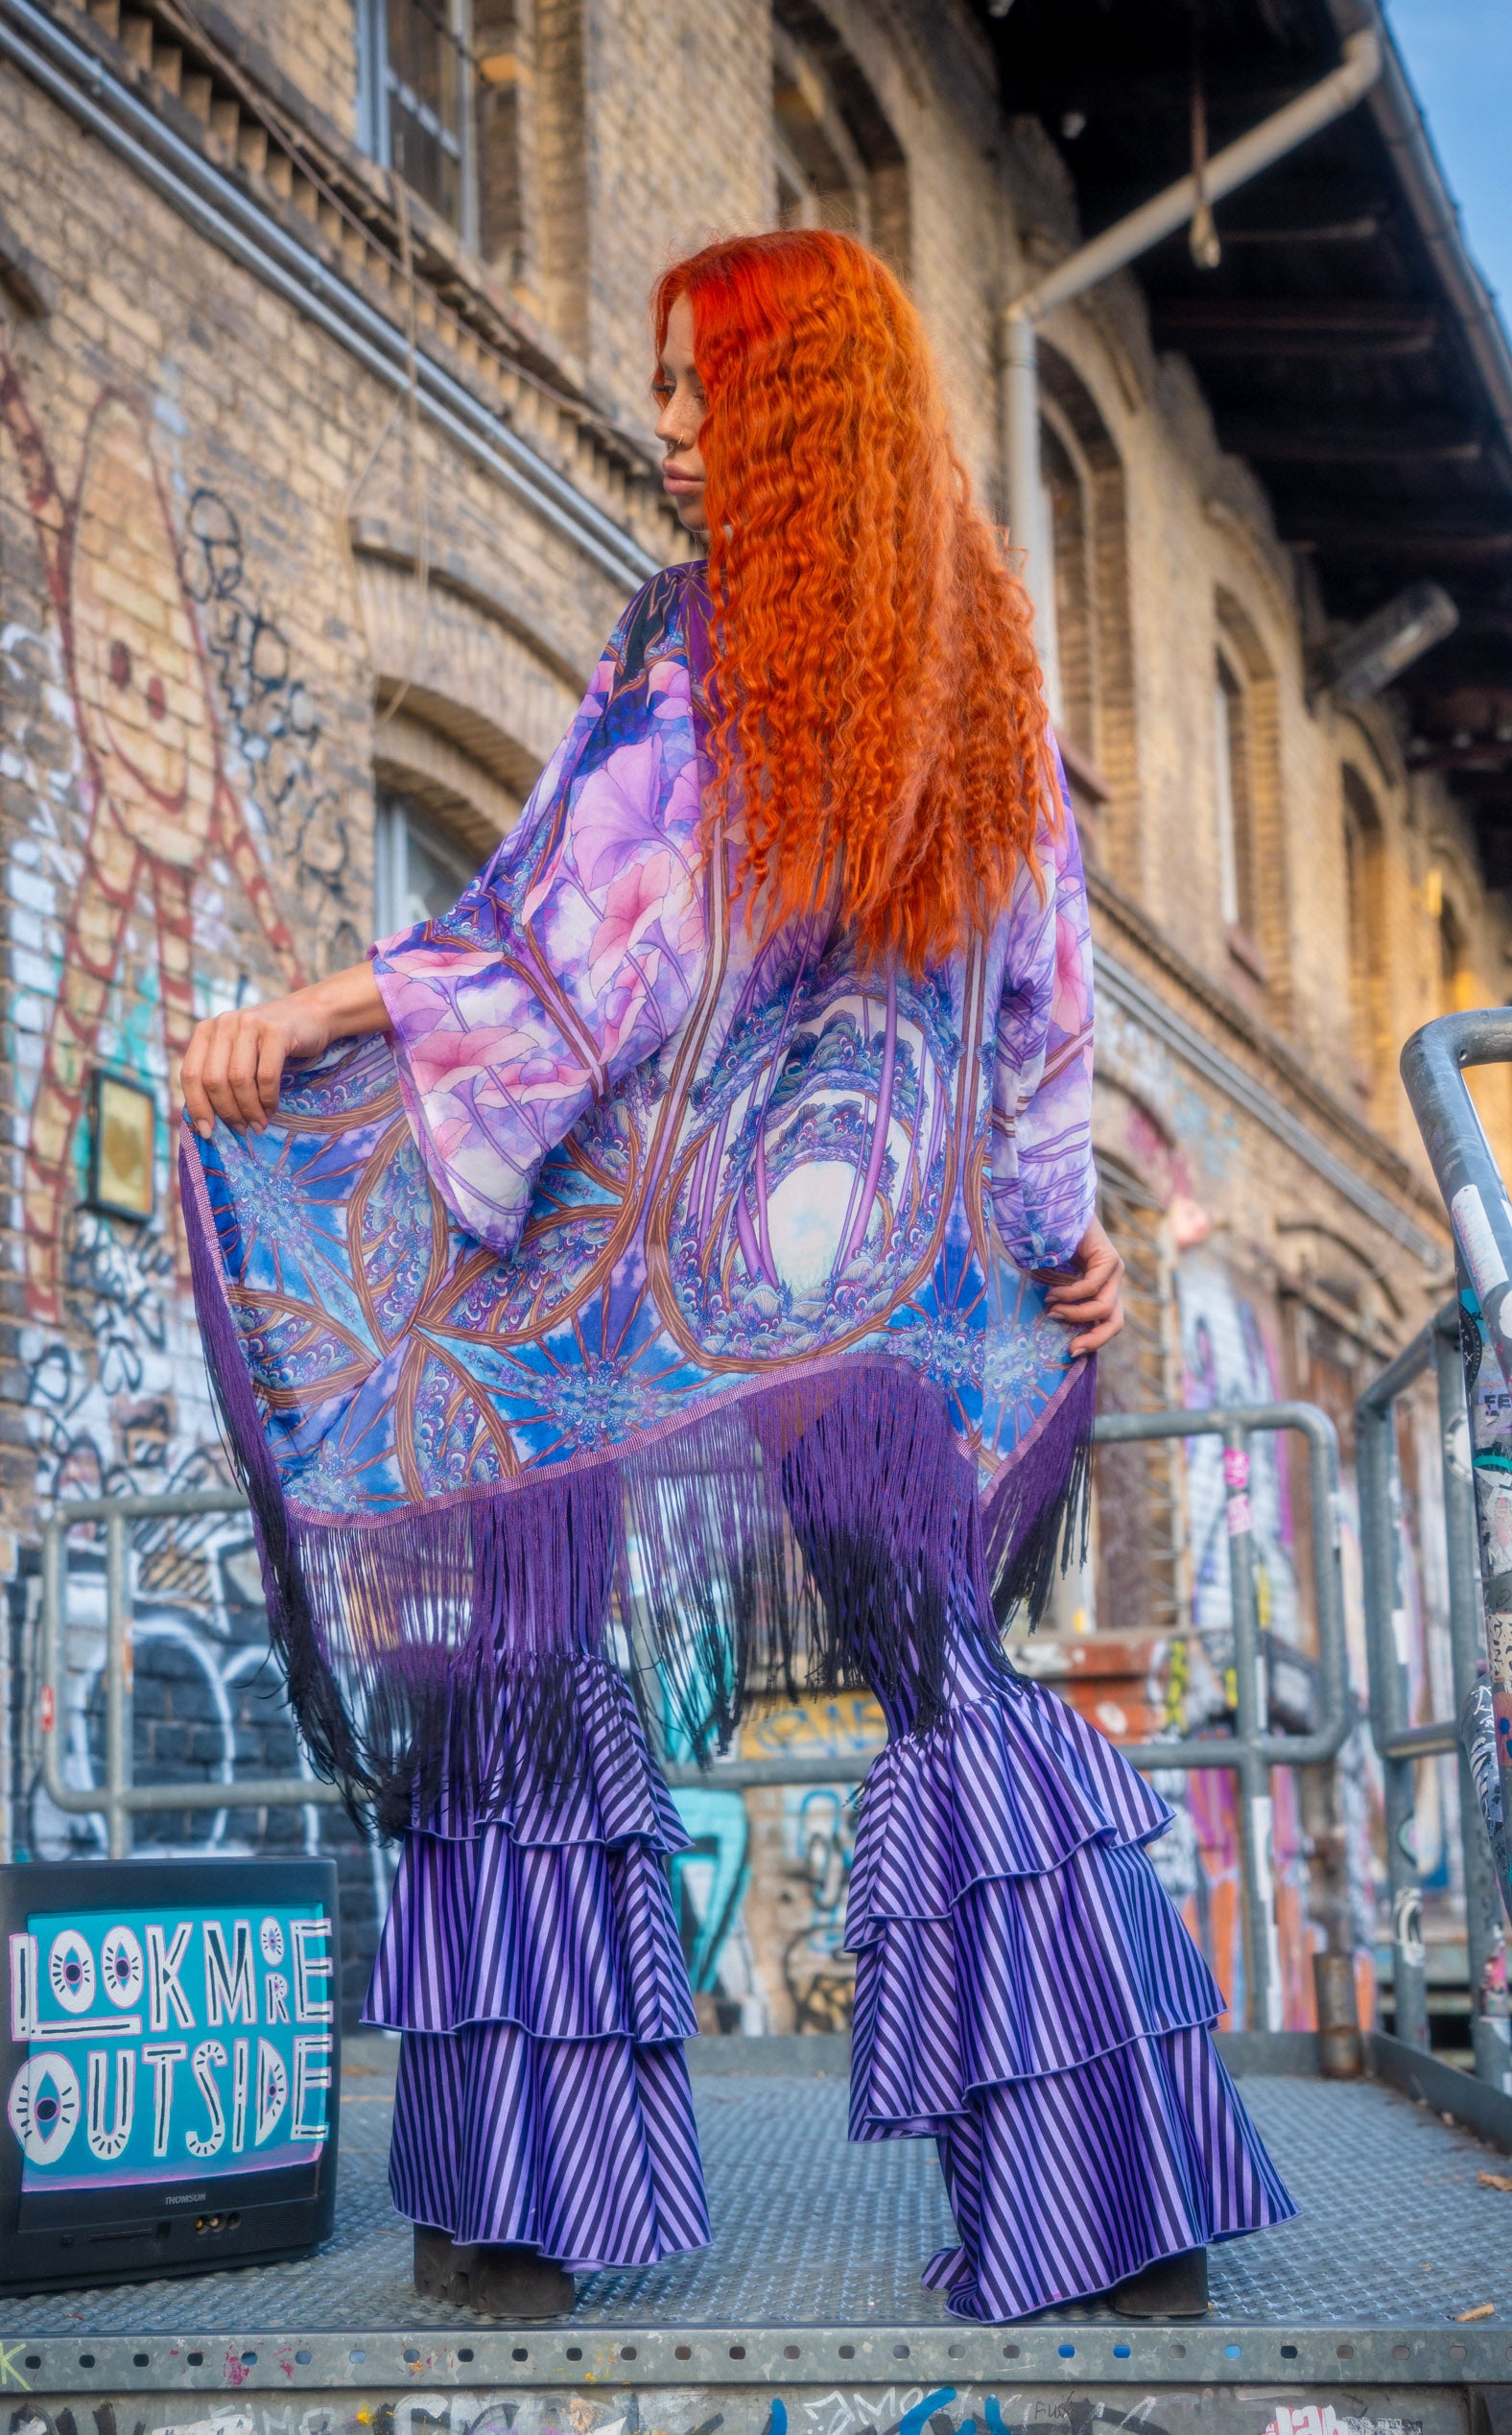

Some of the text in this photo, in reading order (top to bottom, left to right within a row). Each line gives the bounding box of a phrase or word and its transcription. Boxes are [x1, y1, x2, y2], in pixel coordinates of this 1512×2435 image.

[9, 1916, 334, 2042] LOOK MORE
[8, 2034, 333, 2166] OUTSIDE
[165, 2192, 206, 2206] THOMSON
